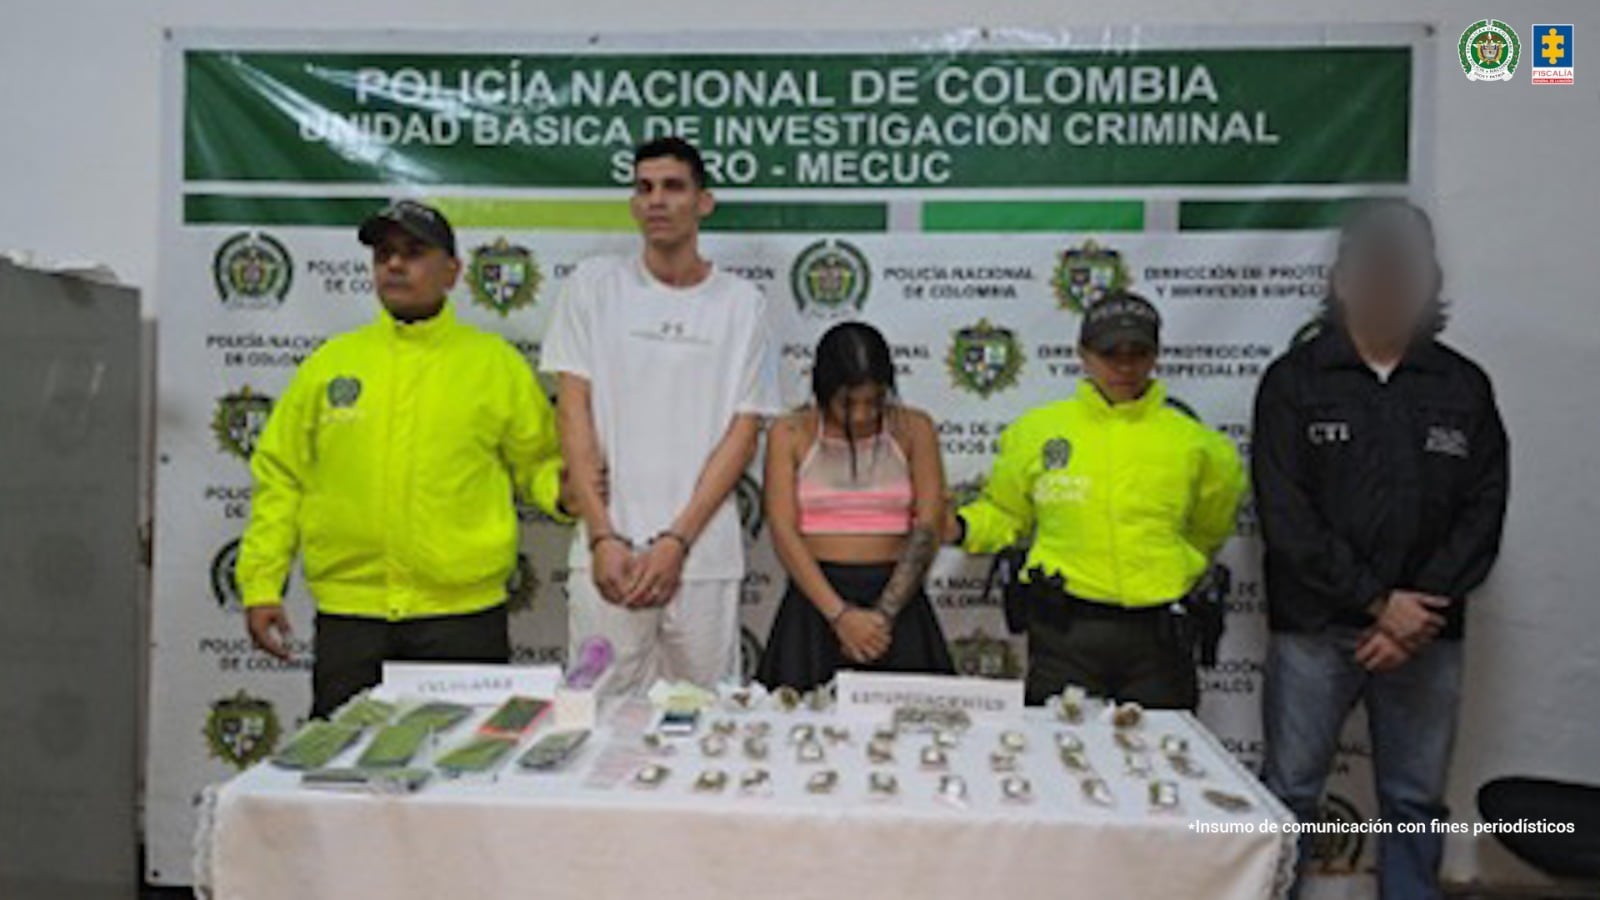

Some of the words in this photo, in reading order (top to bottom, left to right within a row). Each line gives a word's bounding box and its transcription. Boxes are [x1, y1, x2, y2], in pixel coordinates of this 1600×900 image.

[356, 60, 556, 108] POLICÍA
[569, 69, 834, 108] NACIONAL
[851, 69, 920, 106] DE
[936, 66, 1218, 105] COLOMBIA
[301, 112, 460, 145] UNIDAD
[473, 108, 630, 145] BÁSICA
[714, 106, 1052, 146] INVESTIGACIÓN
[1064, 112, 1279, 145] CRIMINAL
[612, 151, 757, 184] SRO
[796, 151, 953, 184] MECUC
[883, 266, 948, 281] POLICÍA
[951, 267, 1036, 281] NACIONAL
[205, 486, 252, 499] POLIC
[200, 639, 248, 653] POLIC
